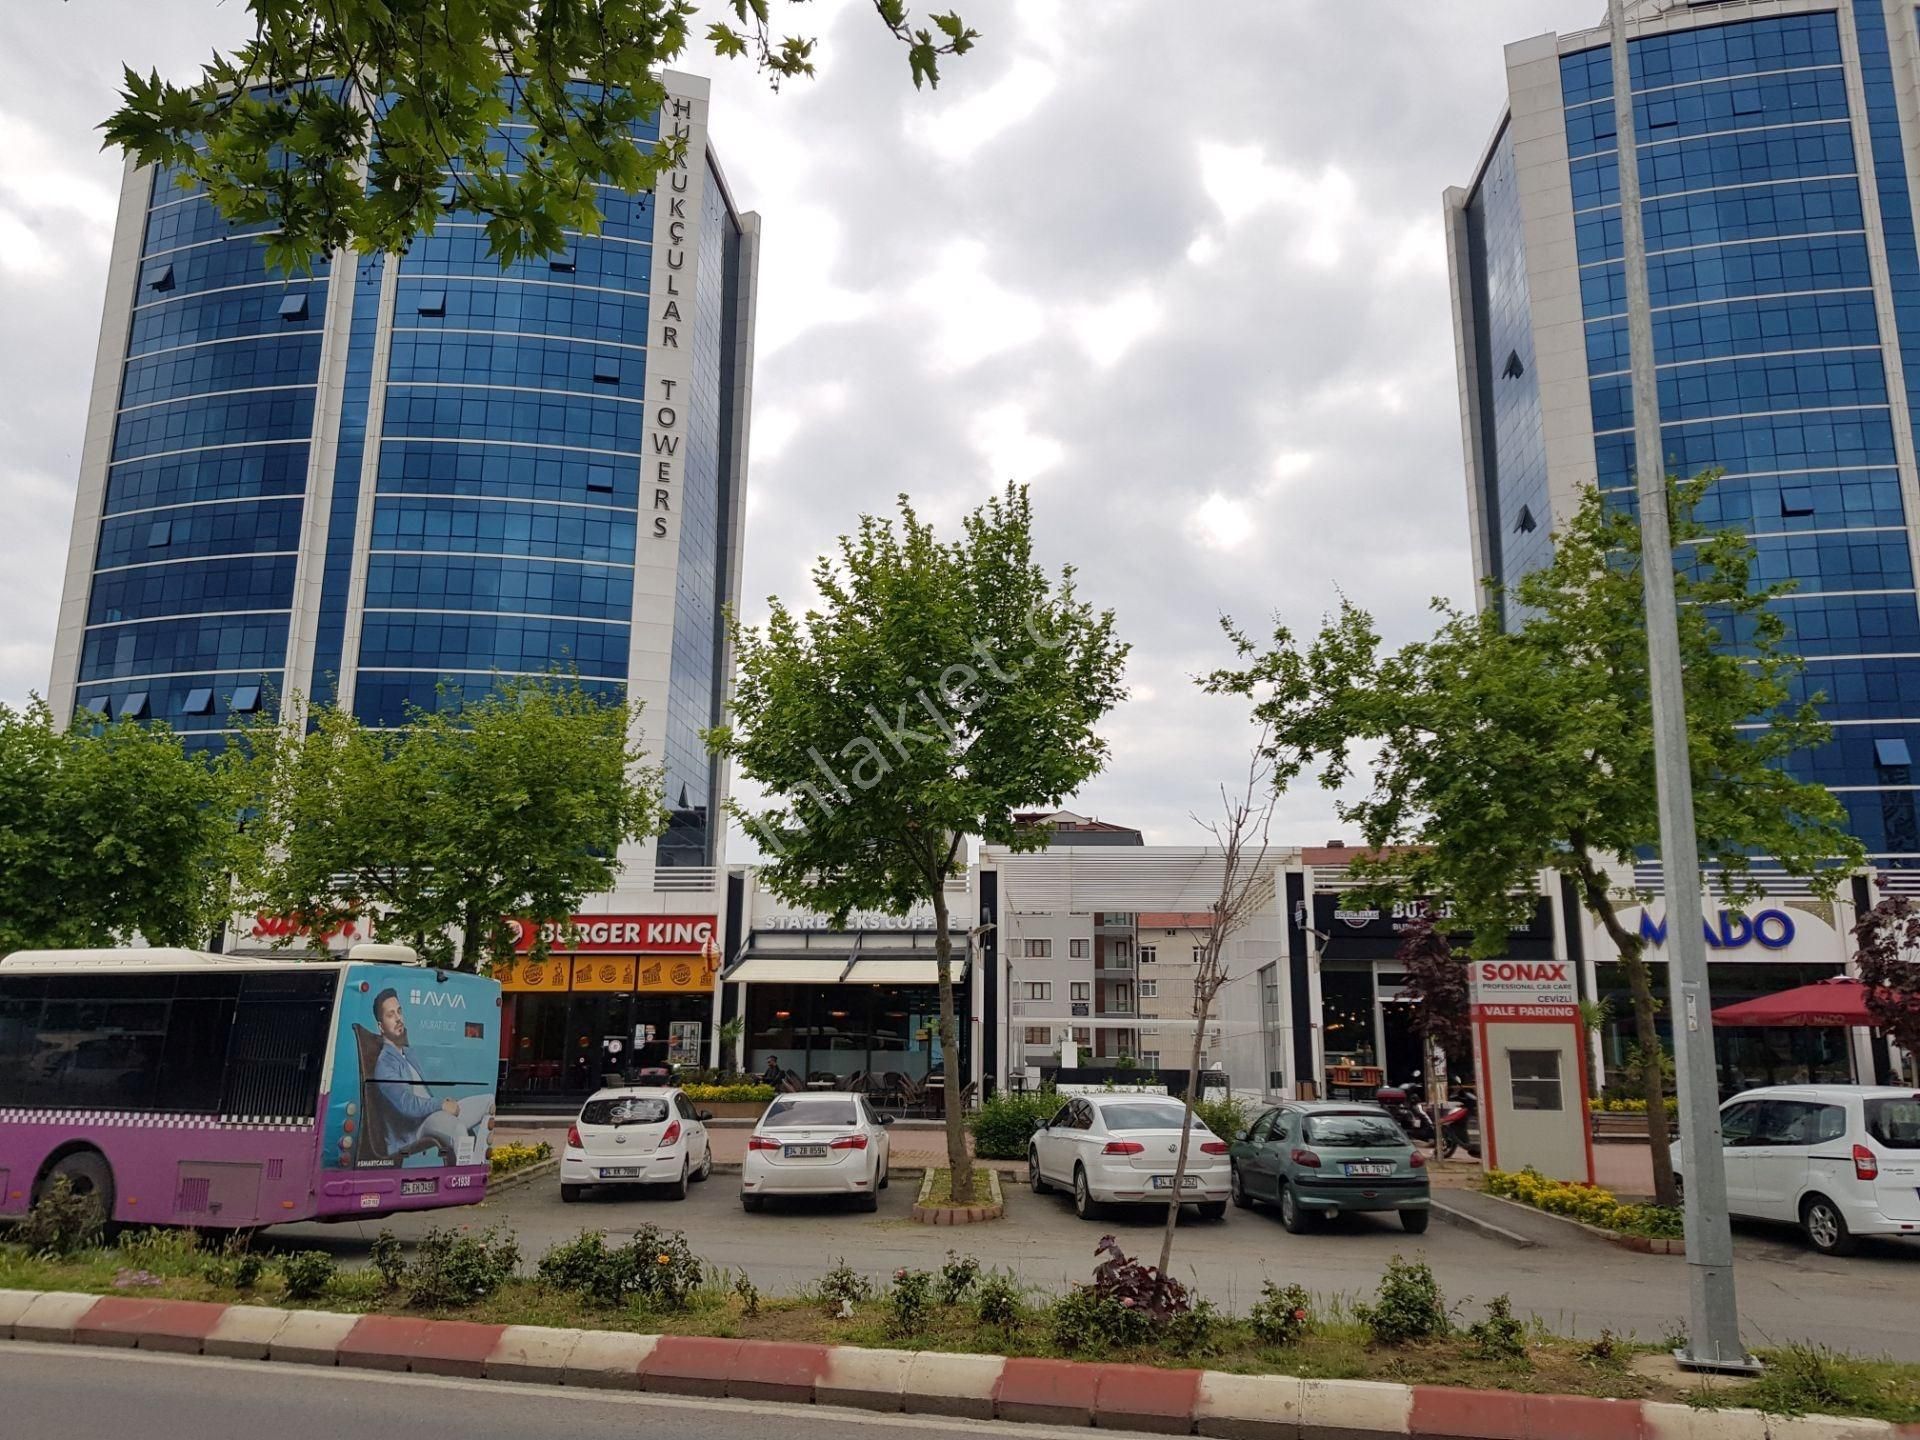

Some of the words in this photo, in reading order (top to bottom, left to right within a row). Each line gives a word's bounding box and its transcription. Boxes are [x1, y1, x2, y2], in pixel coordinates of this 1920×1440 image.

[653, 379, 679, 538] TOWERS
[765, 915, 880, 929] STARBCKS
[885, 915, 958, 929] COFFE
[541, 922, 640, 944] BURGER
[646, 922, 712, 944] KING
[1482, 963, 1566, 981] SONAX
[423, 991, 466, 1009] AVVA
[1538, 995, 1572, 1003] CEVİZLİ
[1484, 1006, 1516, 1016] VALE
[1519, 1006, 1574, 1017] PARKING
[451, 1175, 470, 1187] C-1938
